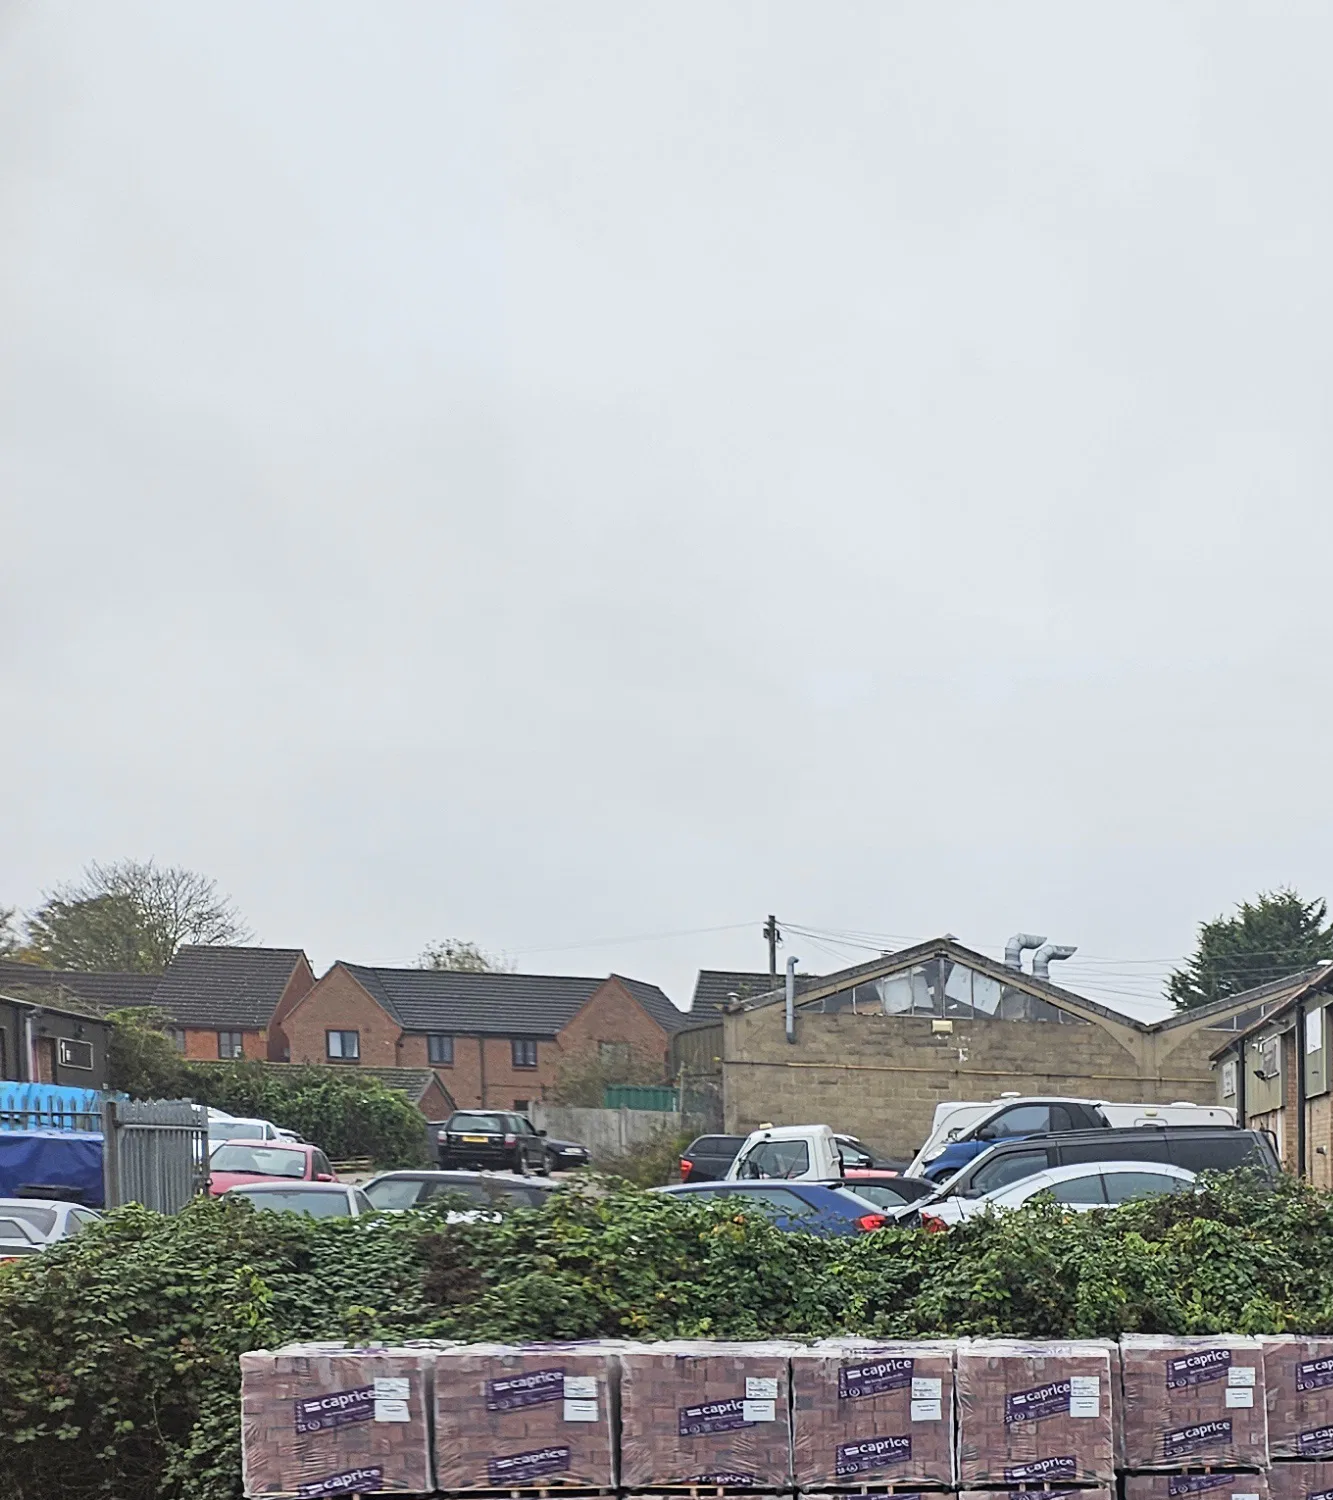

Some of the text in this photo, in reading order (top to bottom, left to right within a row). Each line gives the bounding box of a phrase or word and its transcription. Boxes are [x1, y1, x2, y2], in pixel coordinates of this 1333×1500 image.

[862, 1359, 912, 1378] caprice
[1187, 1350, 1230, 1369] caprice
[510, 1371, 563, 1389] caprice
[321, 1389, 375, 1410] caprice
[1026, 1382, 1071, 1402] caprice
[702, 1400, 745, 1417] capric
[1185, 1421, 1231, 1439] caprice
[859, 1436, 909, 1454] caprice
[512, 1449, 568, 1466] caprice
[1026, 1457, 1075, 1475] caprice
[324, 1468, 381, 1490] caprice
